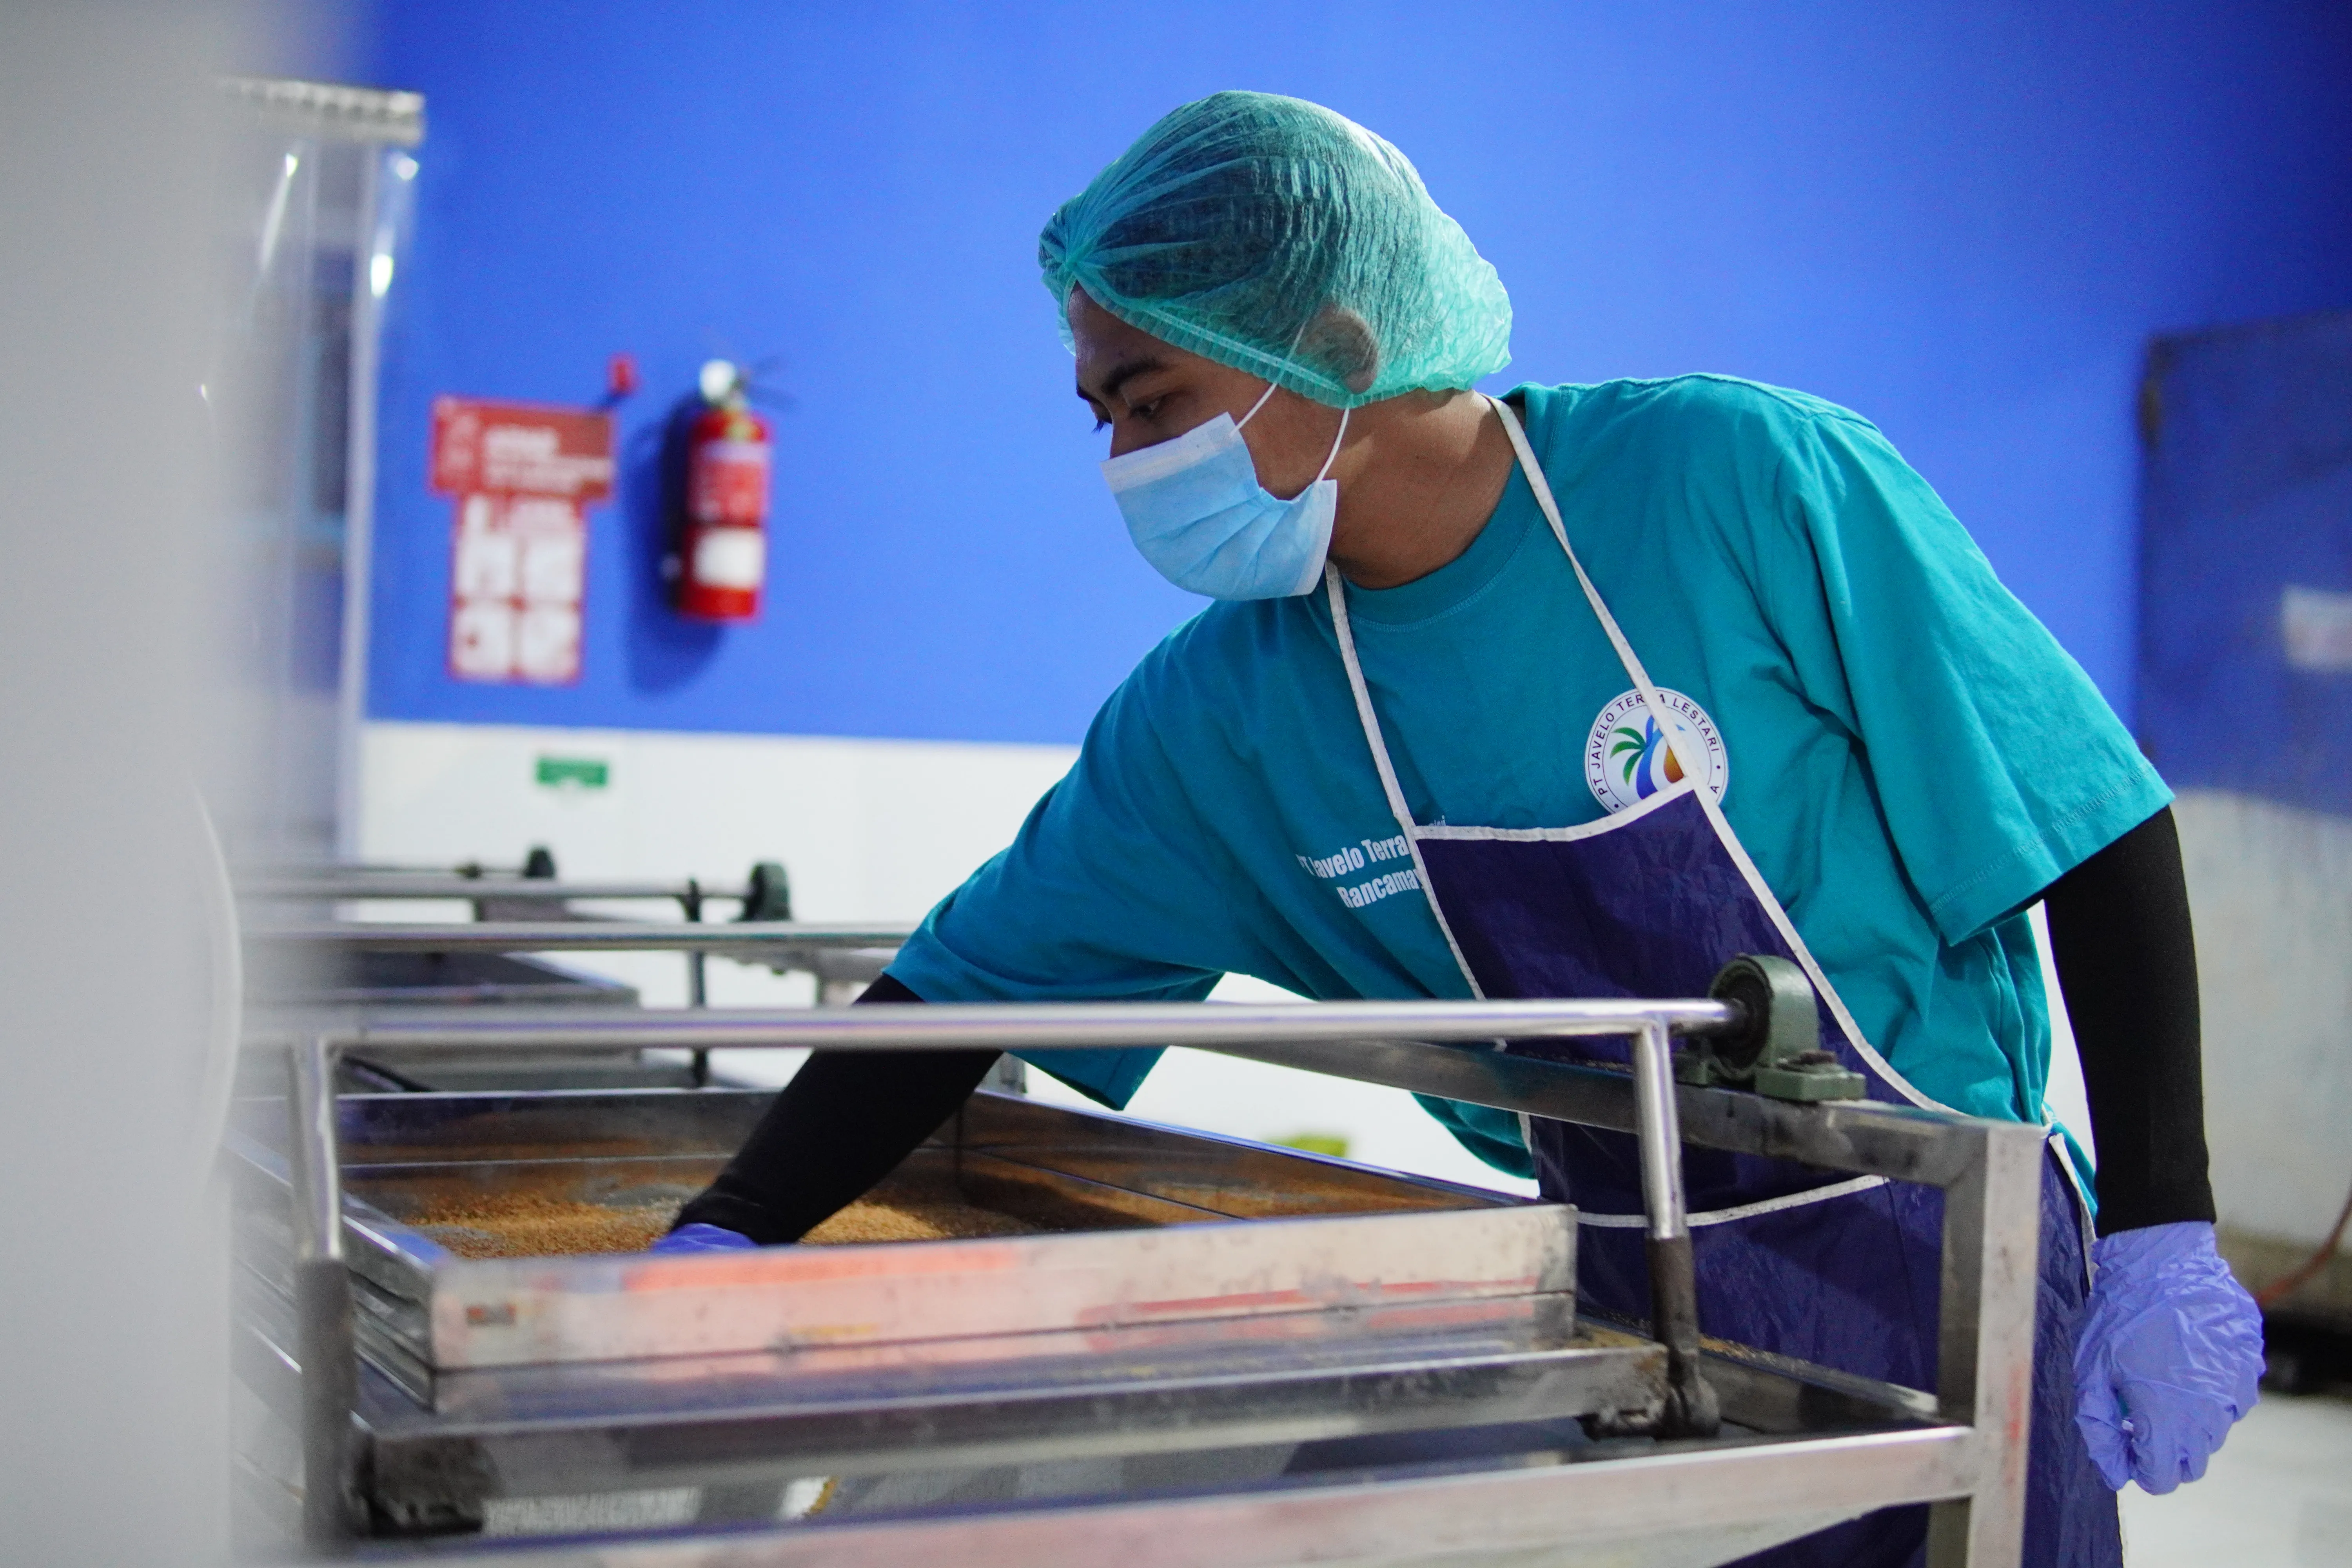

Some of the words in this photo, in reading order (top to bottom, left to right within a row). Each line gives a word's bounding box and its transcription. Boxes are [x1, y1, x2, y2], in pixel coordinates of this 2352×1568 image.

[1616, 694, 1665, 711] TER
[1673, 698, 1719, 751] LESTARI
[1591, 713, 1615, 769] JAVELO
[1593, 779, 1608, 795] PT
[1361, 835, 1411, 862] Terra
